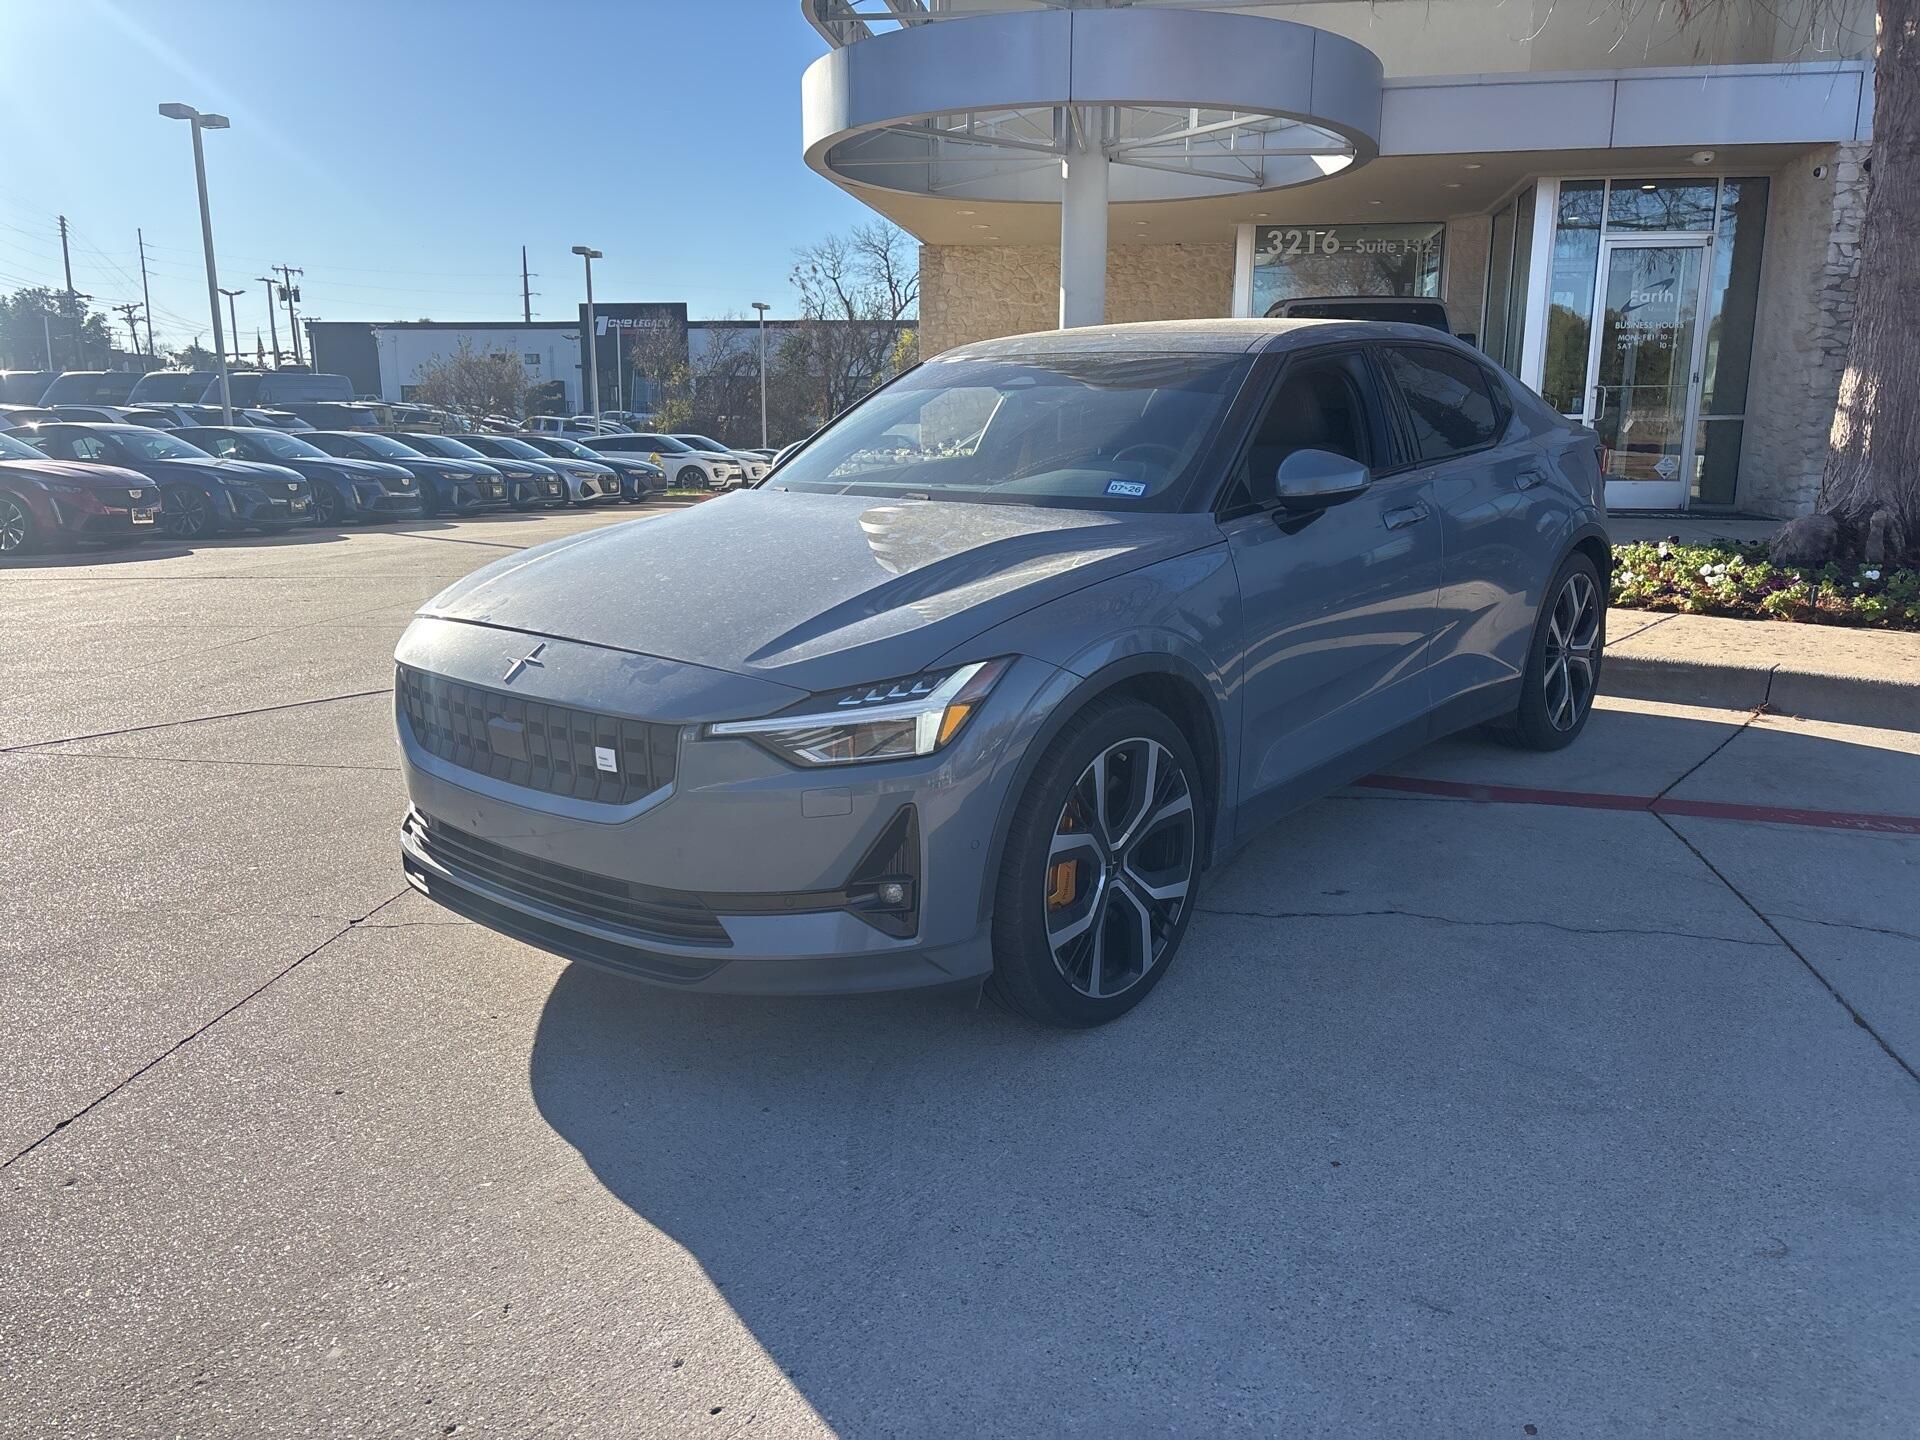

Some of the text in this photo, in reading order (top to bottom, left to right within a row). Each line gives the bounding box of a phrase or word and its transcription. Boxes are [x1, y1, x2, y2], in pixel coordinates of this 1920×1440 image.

[1266, 229, 1340, 255] 3216
[1356, 239, 1397, 254] Suite
[1402, 238, 1433, 254] 132
[1630, 288, 1674, 305] Earth
[1615, 321, 1685, 329] BUSINESS HOURS
[1617, 342, 1632, 350] SAT
